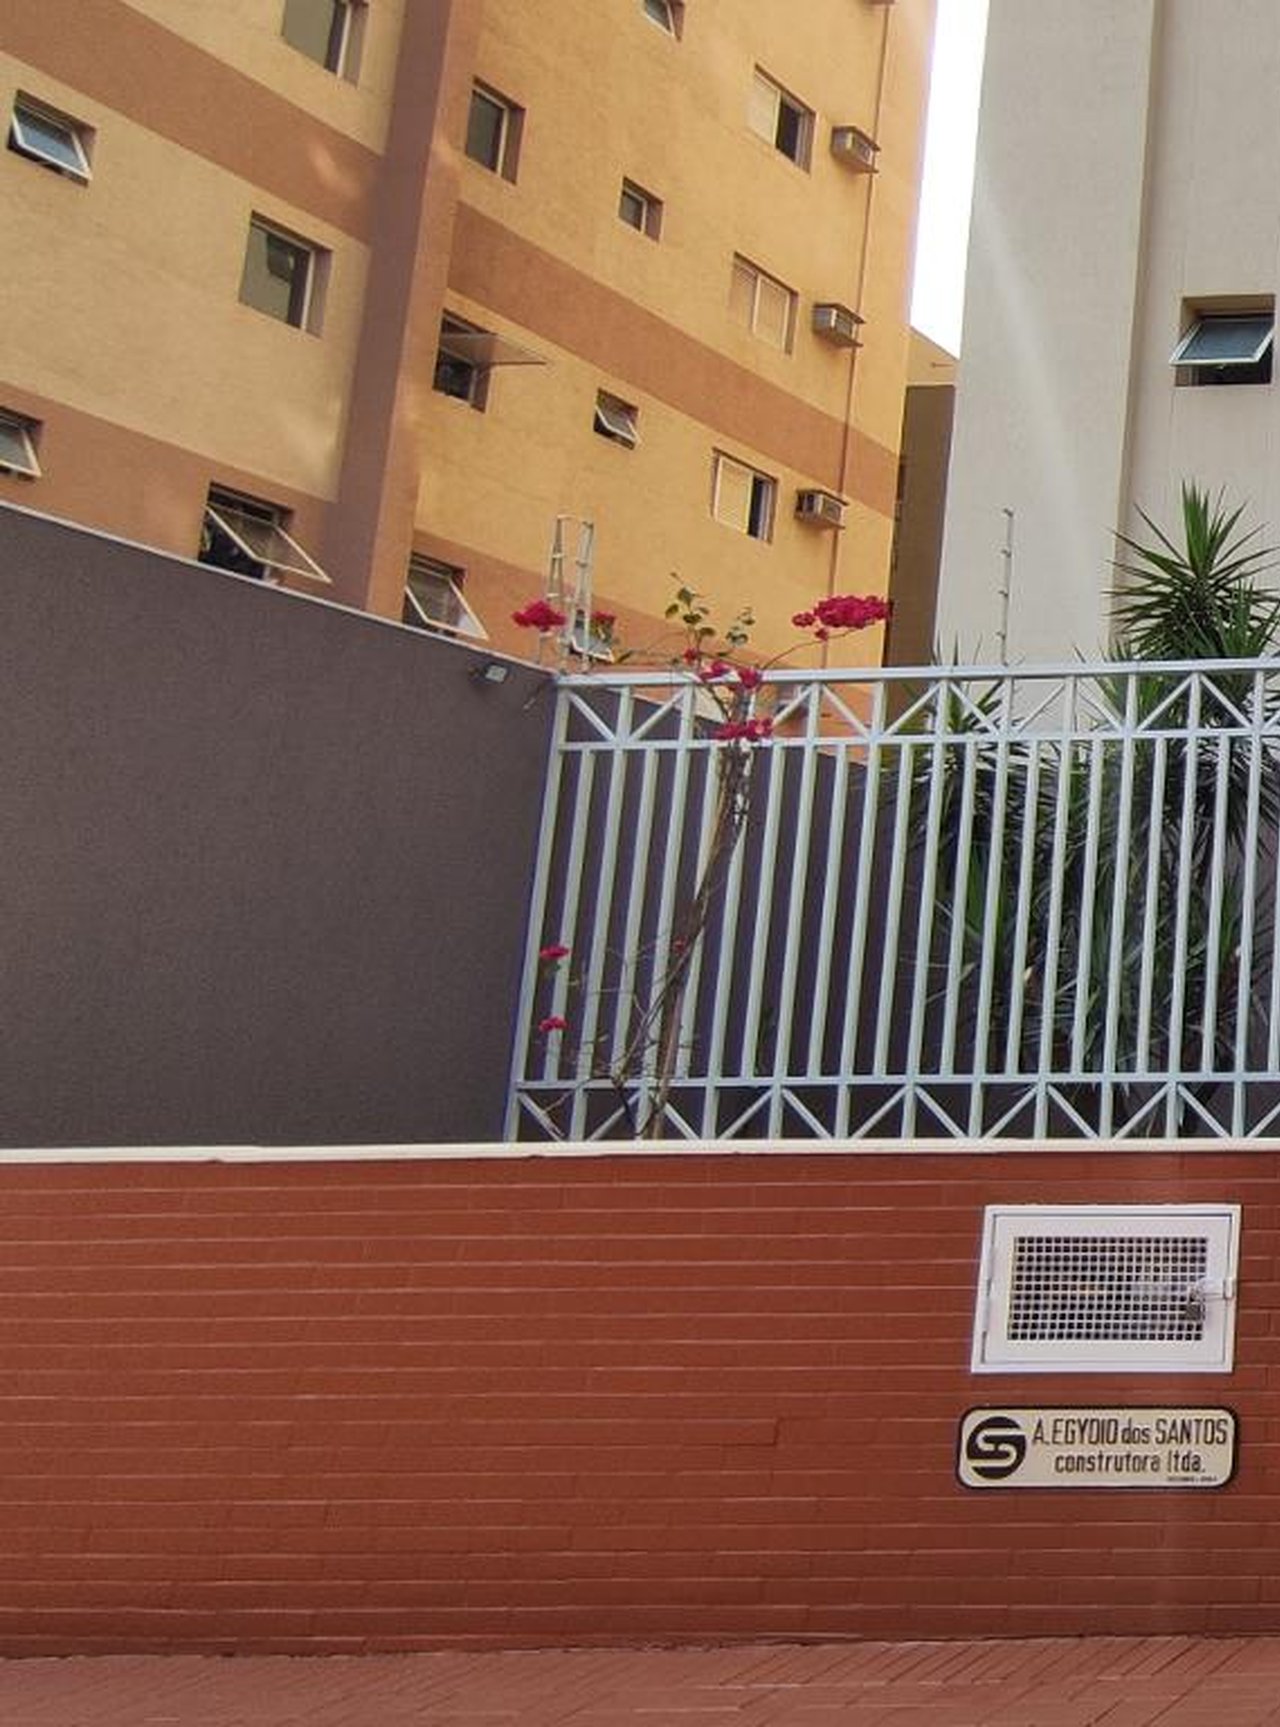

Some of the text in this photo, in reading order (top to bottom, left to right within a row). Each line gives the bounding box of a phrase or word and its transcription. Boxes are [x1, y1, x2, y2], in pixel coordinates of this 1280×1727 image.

[1121, 1416, 1150, 1445] dos
[1154, 1417, 1229, 1446] SANTOS
[1054, 1450, 1206, 1474] construtora ltda.
